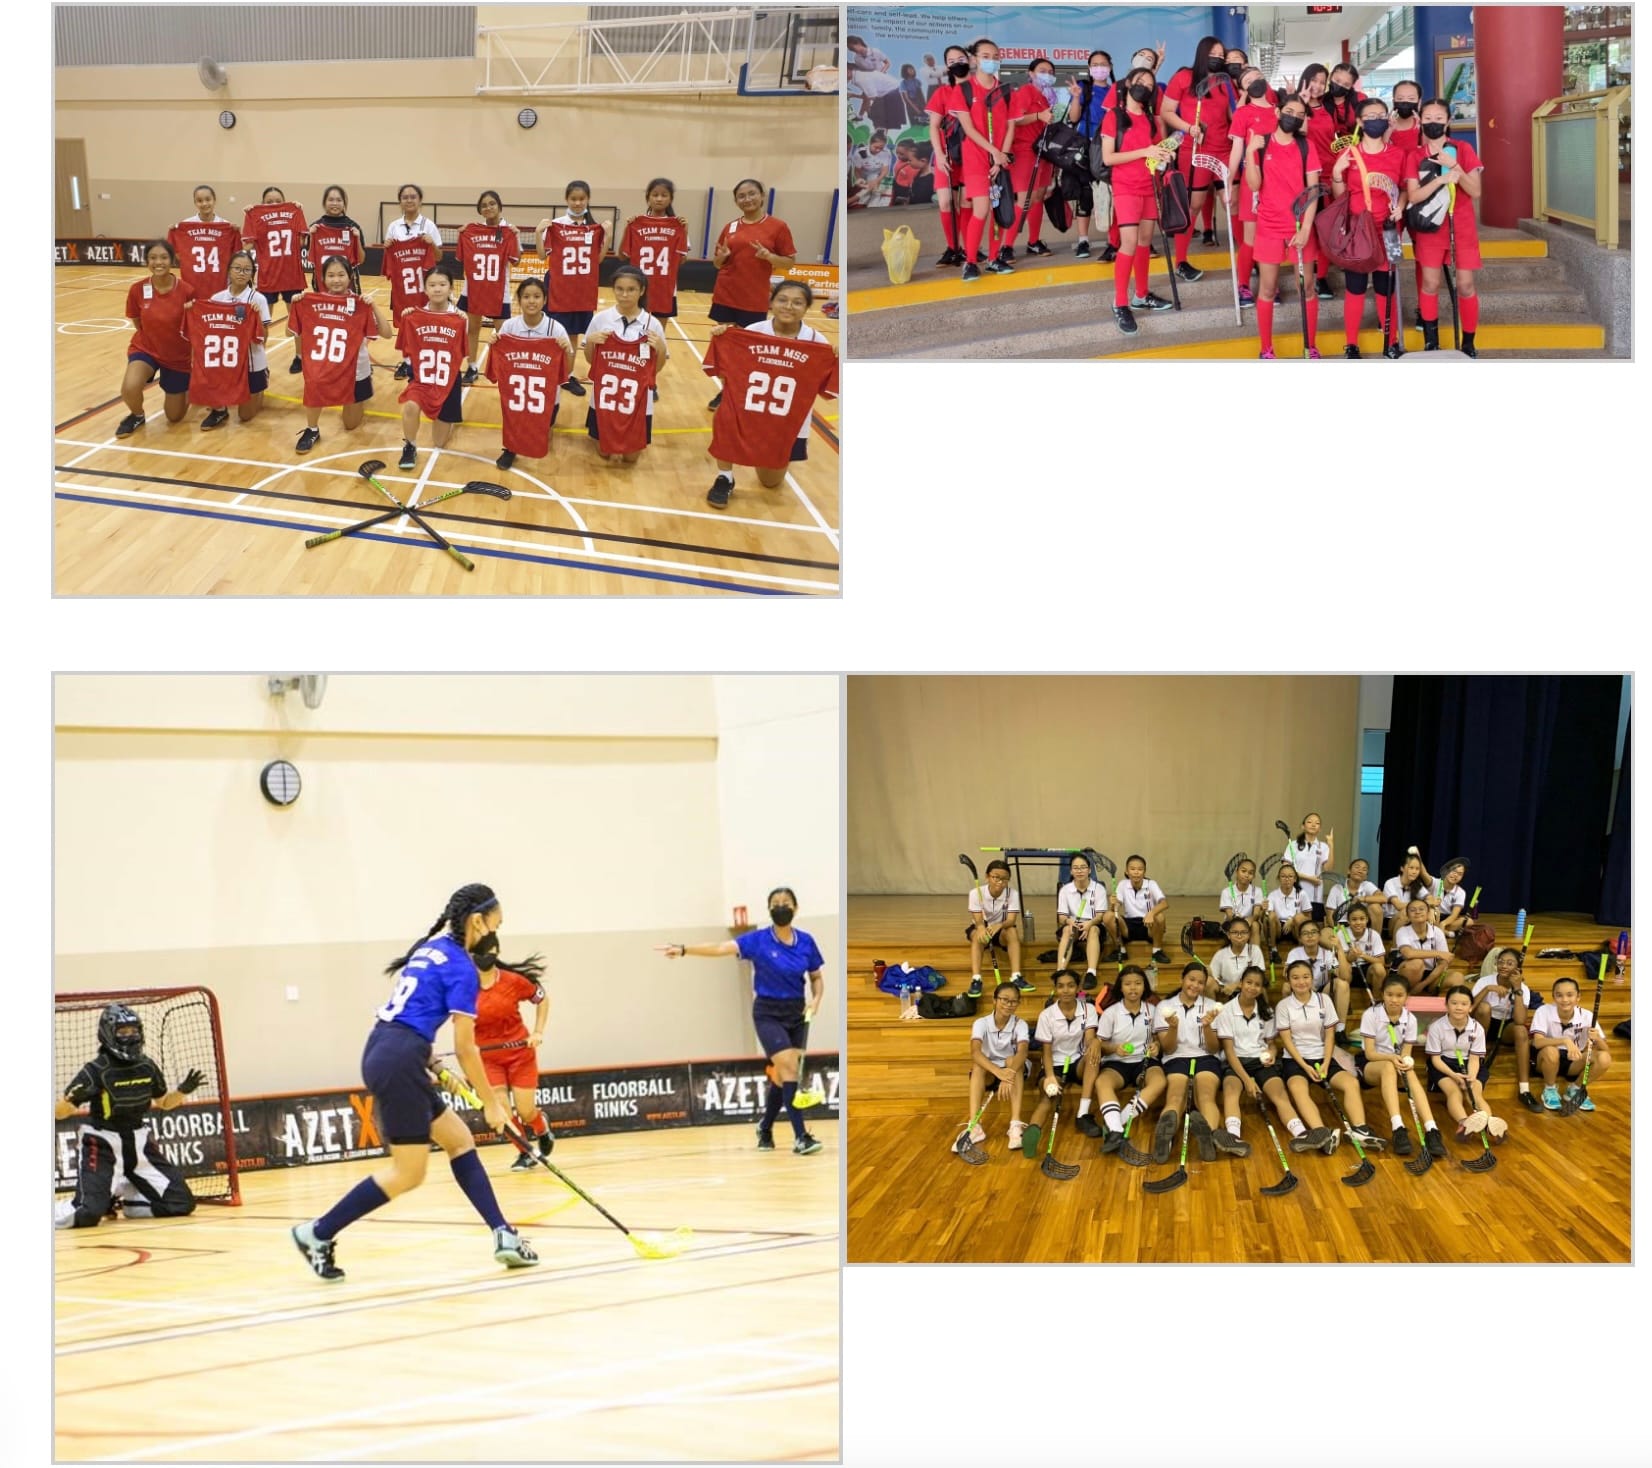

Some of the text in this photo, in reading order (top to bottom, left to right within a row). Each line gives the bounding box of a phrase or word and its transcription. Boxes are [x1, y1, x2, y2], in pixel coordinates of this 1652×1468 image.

[998, 47, 1090, 60] GENERAL OFFICE
[260, 212, 279, 221] TEAM
[187, 228, 207, 237] TEAM
[470, 235, 488, 243] TEAM
[637, 227, 657, 236] TEAM
[86, 242, 123, 260] AZETX
[267, 229, 292, 257] 27
[318, 238, 336, 246] TEAM
[191, 246, 220, 273] 34
[394, 249, 411, 258] TEAM
[562, 246, 591, 275] 25
[639, 246, 670, 276] 24
[473, 253, 500, 282] 30
[788, 267, 831, 278] Become
[402, 266, 425, 295] 21
[311, 303, 334, 313] TEAM
[201, 313, 224, 324] TEAM
[416, 325, 457, 338] TEAM MSS
[204, 334, 238, 368] 28
[310, 325, 348, 364] 36
[748, 344, 810, 364] TEAM MSS
[419, 349, 451, 387] 26
[505, 351, 552, 365] TEAM MSS
[601, 351, 647, 368] TEAM MSS
[508, 374, 546, 414] 35
[599, 373, 639, 415] 23
[744, 370, 797, 417] 29
[592, 1078, 676, 1100] FLOORBALL
[704, 1067, 779, 1111] AZET
[594, 1099, 638, 1119] RINKS
[283, 1093, 381, 1158] AZETX
